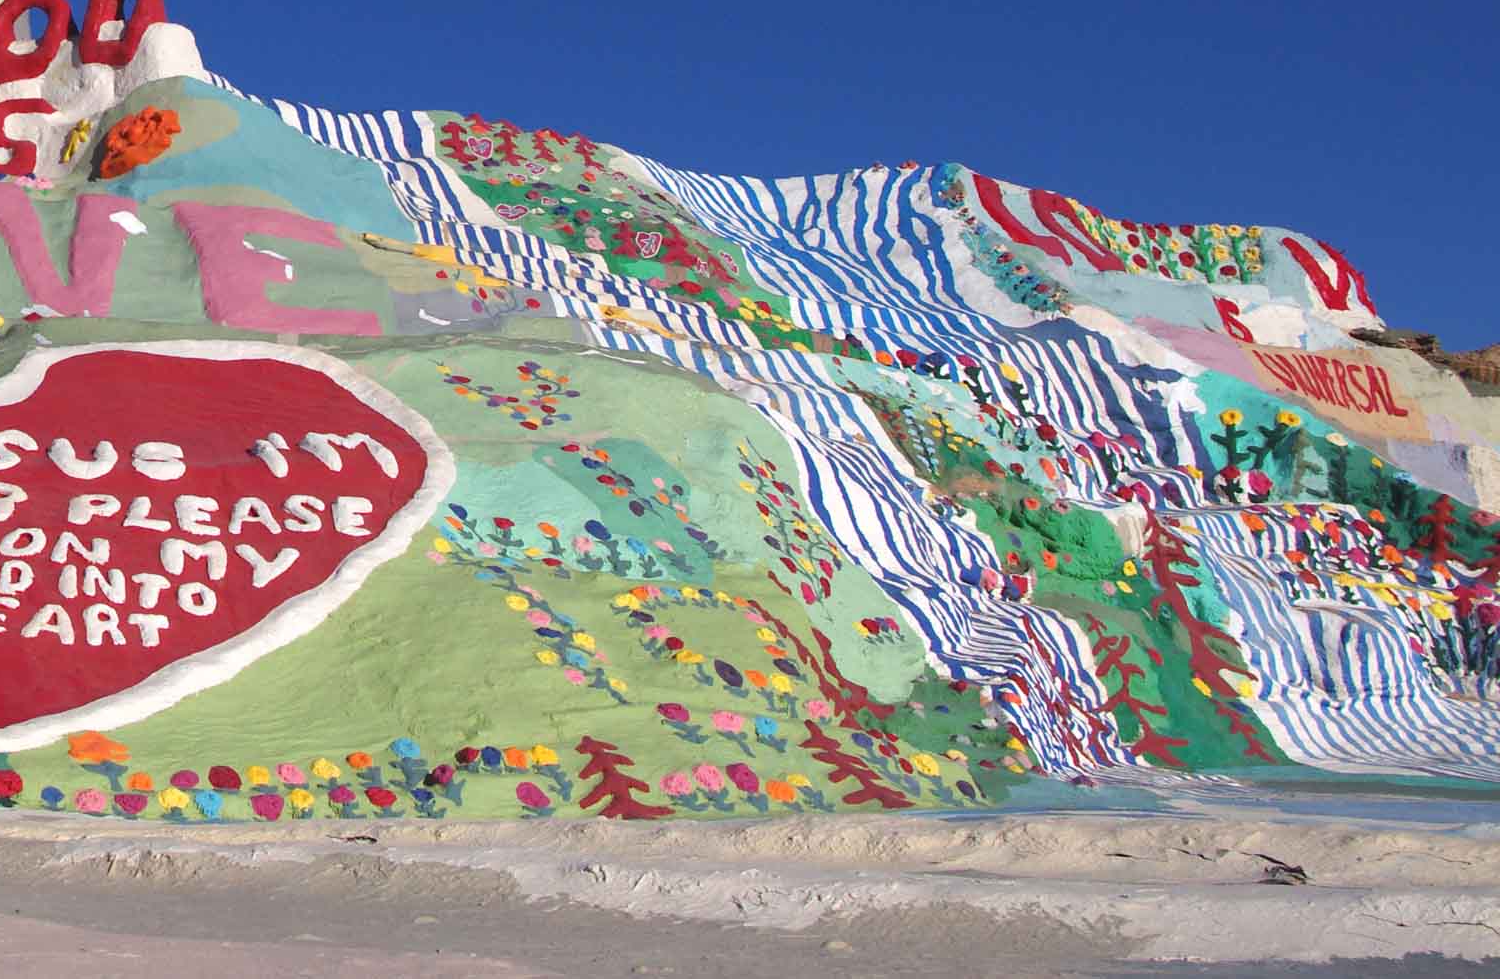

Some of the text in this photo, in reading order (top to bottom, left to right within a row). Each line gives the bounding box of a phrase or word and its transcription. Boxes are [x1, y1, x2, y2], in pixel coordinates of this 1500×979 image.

[248, 431, 400, 479] I'M
[67, 493, 373, 537] PLEASE
[159, 537, 300, 589] MY
[58, 563, 219, 617] INTO
